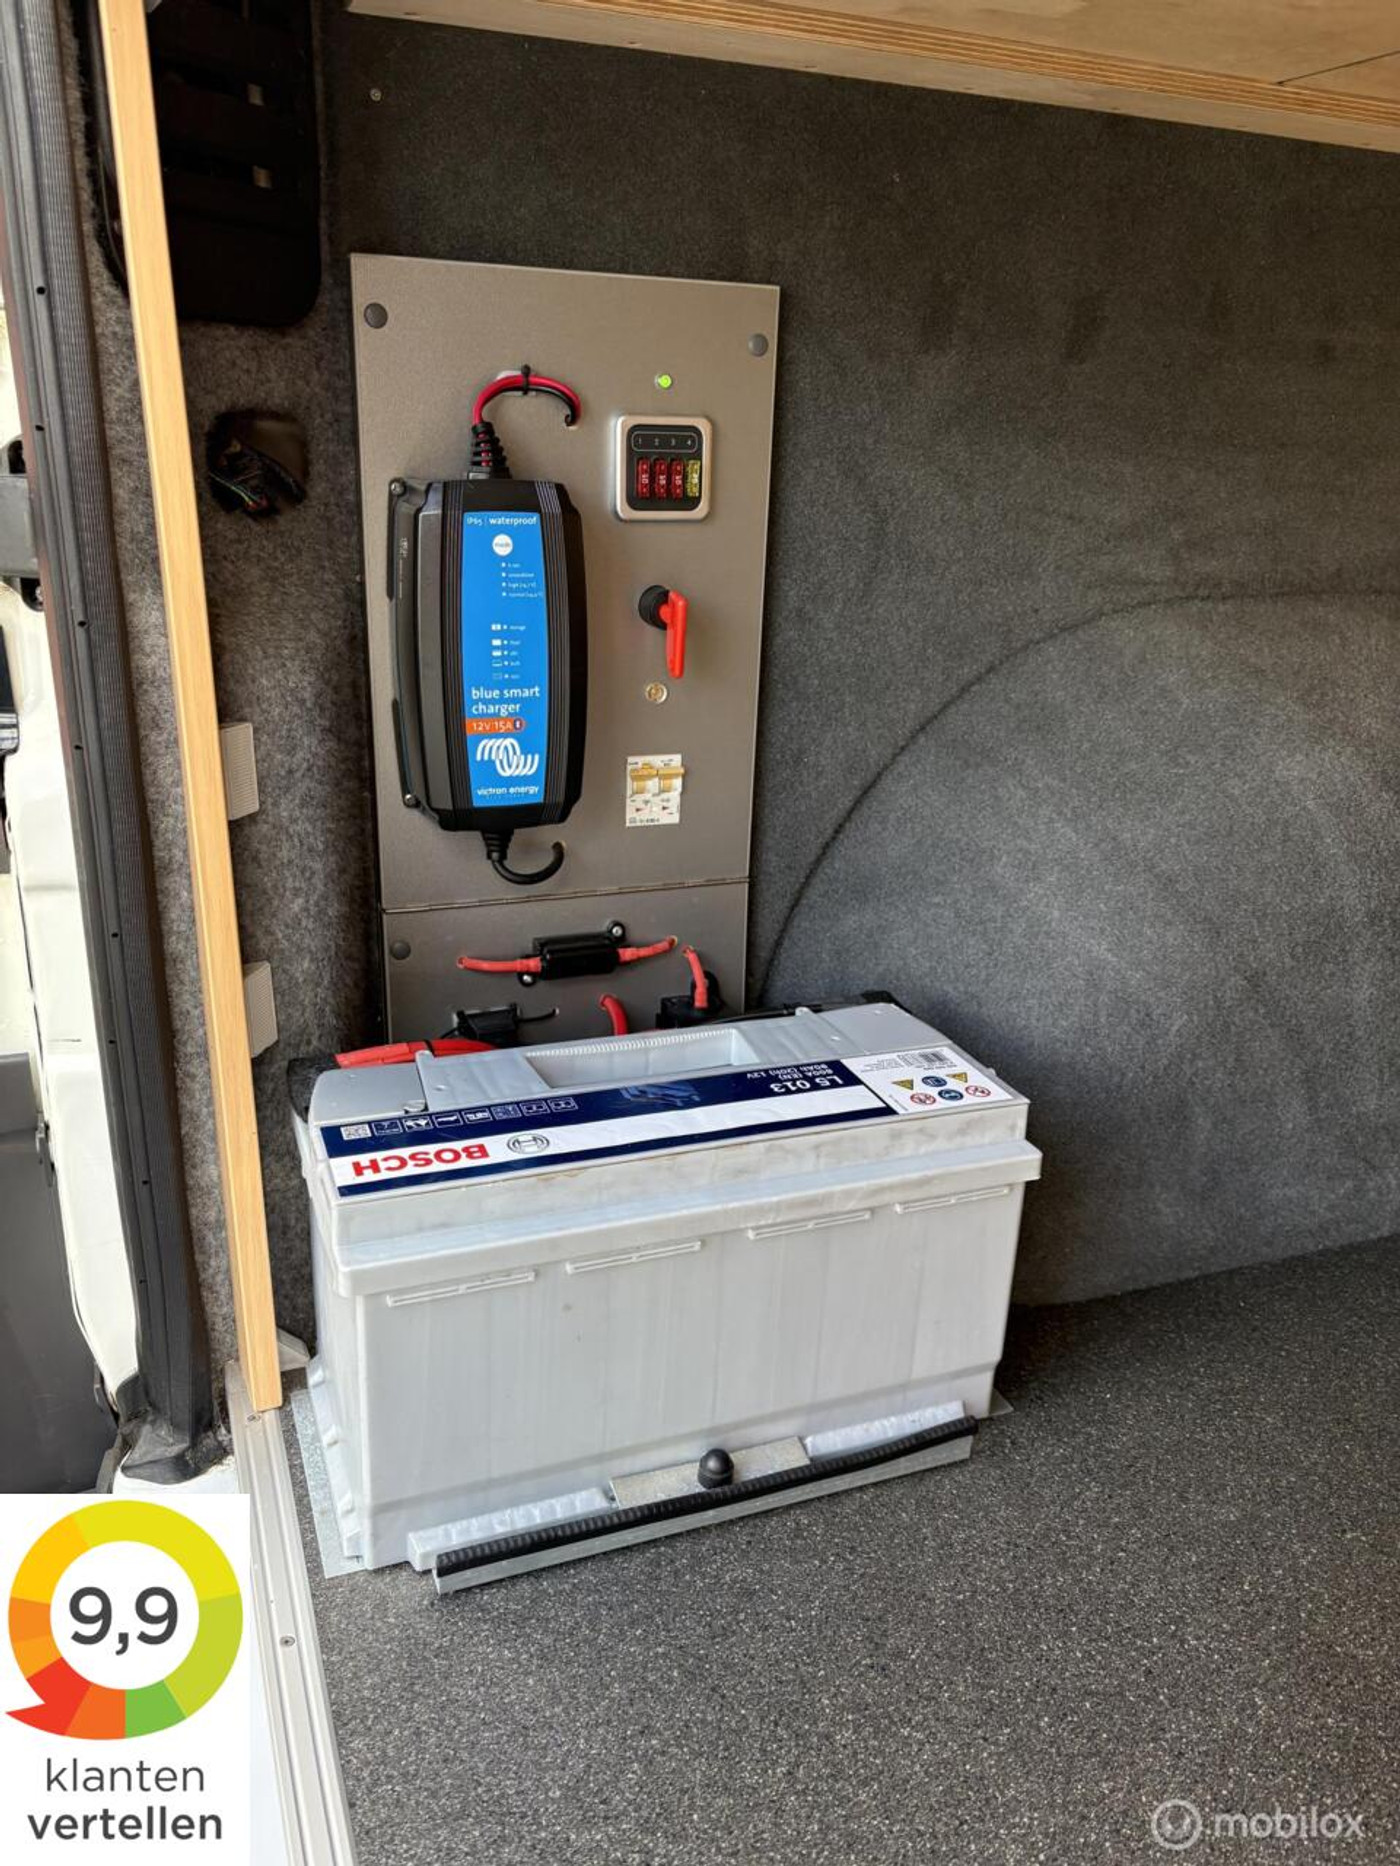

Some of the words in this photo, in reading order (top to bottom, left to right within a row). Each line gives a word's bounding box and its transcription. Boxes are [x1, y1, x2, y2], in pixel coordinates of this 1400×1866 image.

[489, 515, 538, 526] waterproof
[471, 686, 501, 700] blue
[503, 685, 541, 699] smart
[472, 701, 521, 717] charger
[476, 786, 508, 796] victron
[509, 785, 539, 795] energy
[769, 1079, 811, 1093] 013
[351, 1143, 490, 1177] BOSCH
